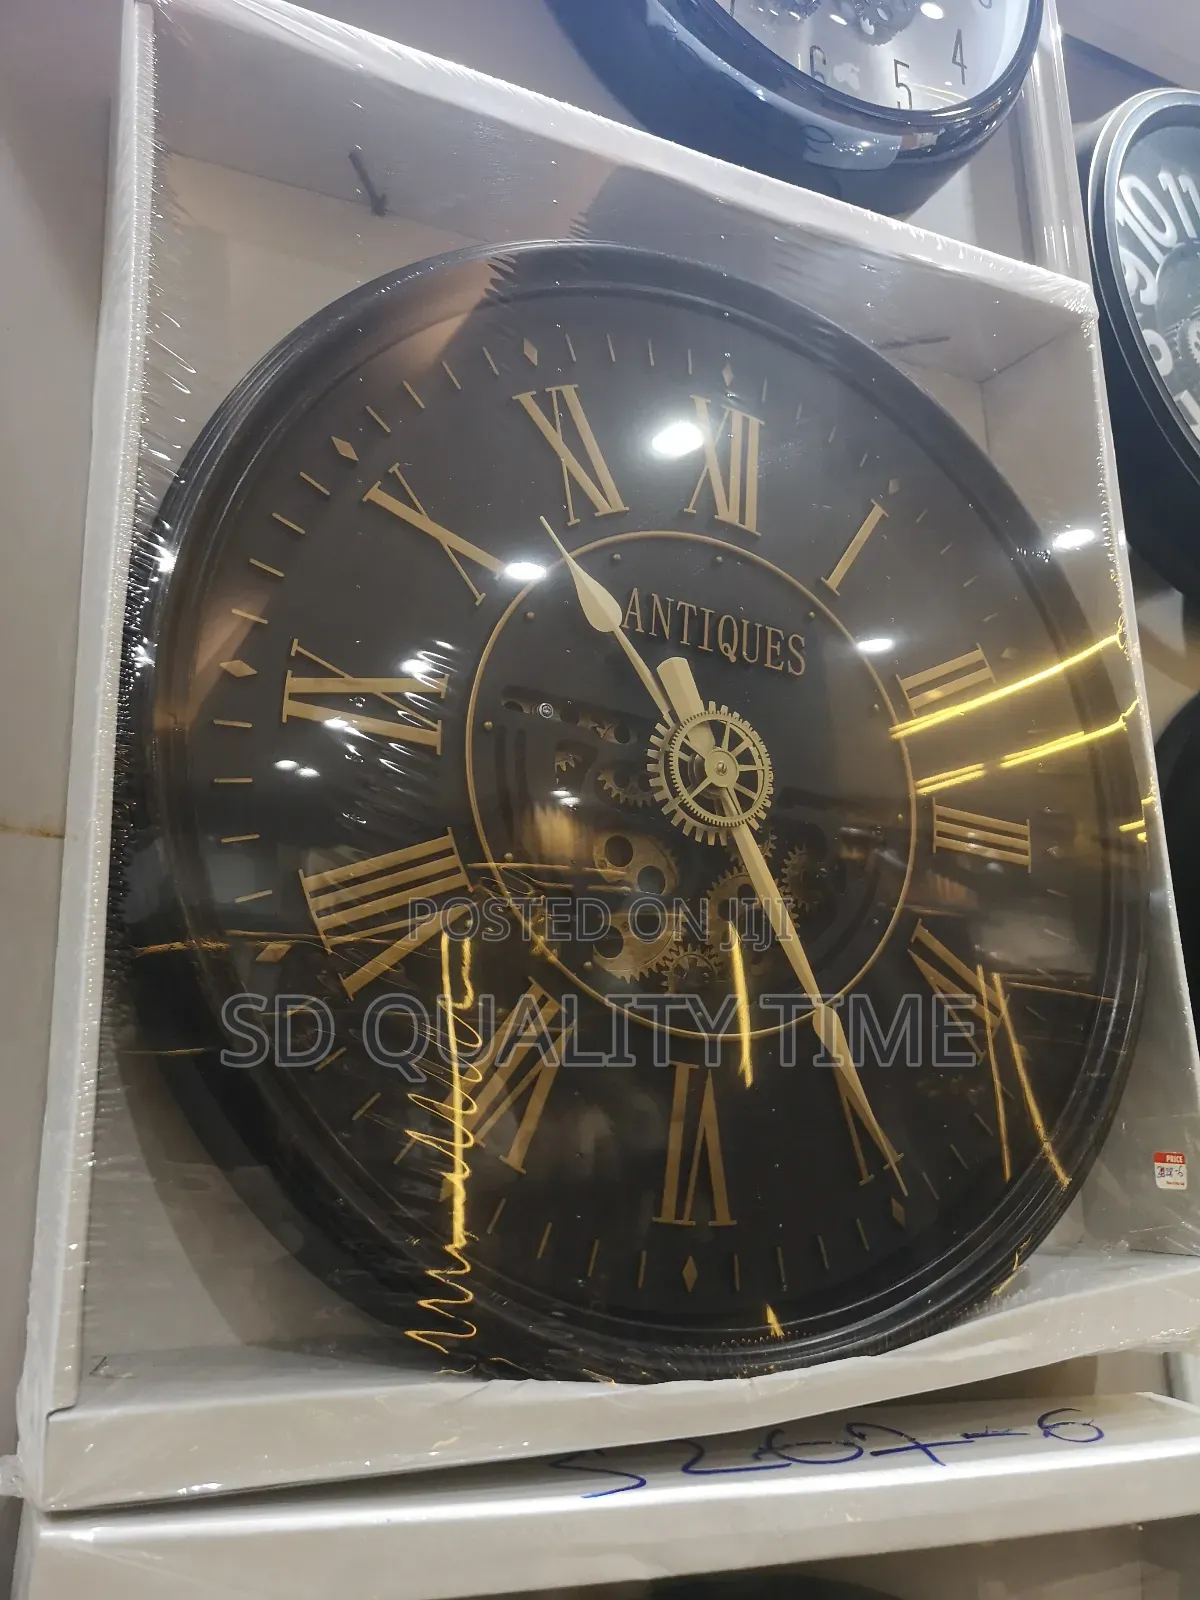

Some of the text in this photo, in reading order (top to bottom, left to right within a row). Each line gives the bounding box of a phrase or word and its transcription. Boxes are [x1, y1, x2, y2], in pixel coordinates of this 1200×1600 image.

[893, 58, 913, 110] 5
[951, 28, 968, 85] 4
[1114, 173, 1178, 265] 10
[512, 384, 630, 527] XI
[683, 394, 764, 537] XII
[363, 462, 504, 606] X
[820, 499, 889, 596] I
[621, 587, 806, 677] ANTIQUES
[282, 638, 450, 755] IX
[932, 797, 1032, 873] III
[652, 1060, 738, 1227] VI
[1165, 1154, 1183, 1163] PRICE
